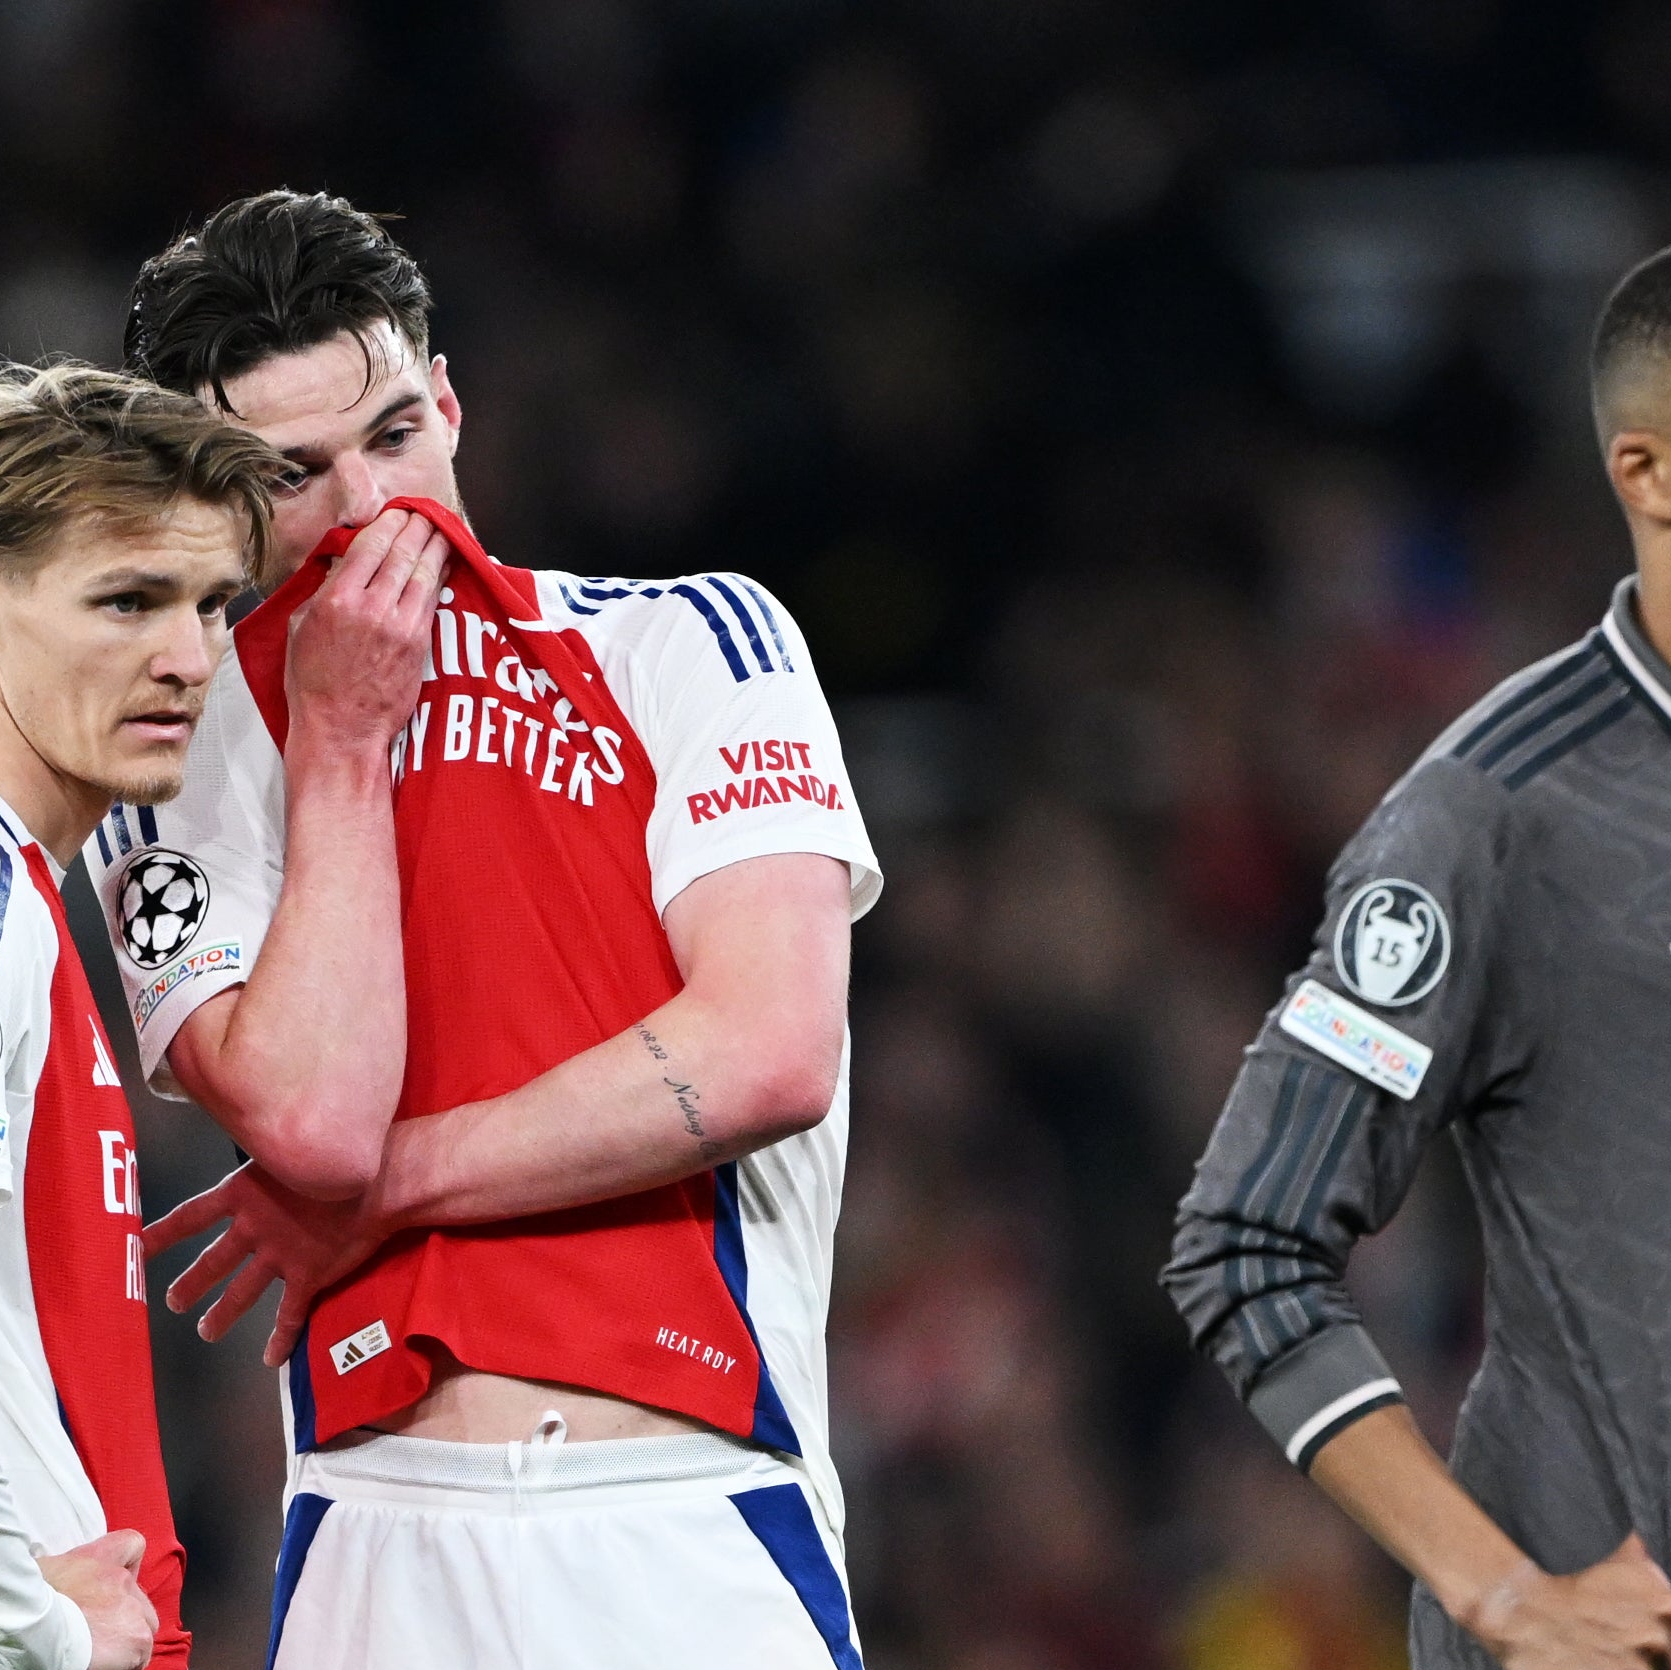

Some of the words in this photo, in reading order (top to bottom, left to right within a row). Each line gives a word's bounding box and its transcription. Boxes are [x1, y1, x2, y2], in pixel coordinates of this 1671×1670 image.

[443, 694, 595, 807] BETTER
[718, 739, 812, 775] VISIT
[686, 774, 845, 825] RWANDA
[1372, 936, 1405, 967] 15
[134, 947, 240, 1030] FOUNDATION
[655, 1326, 737, 1375] HEAT.RDY
